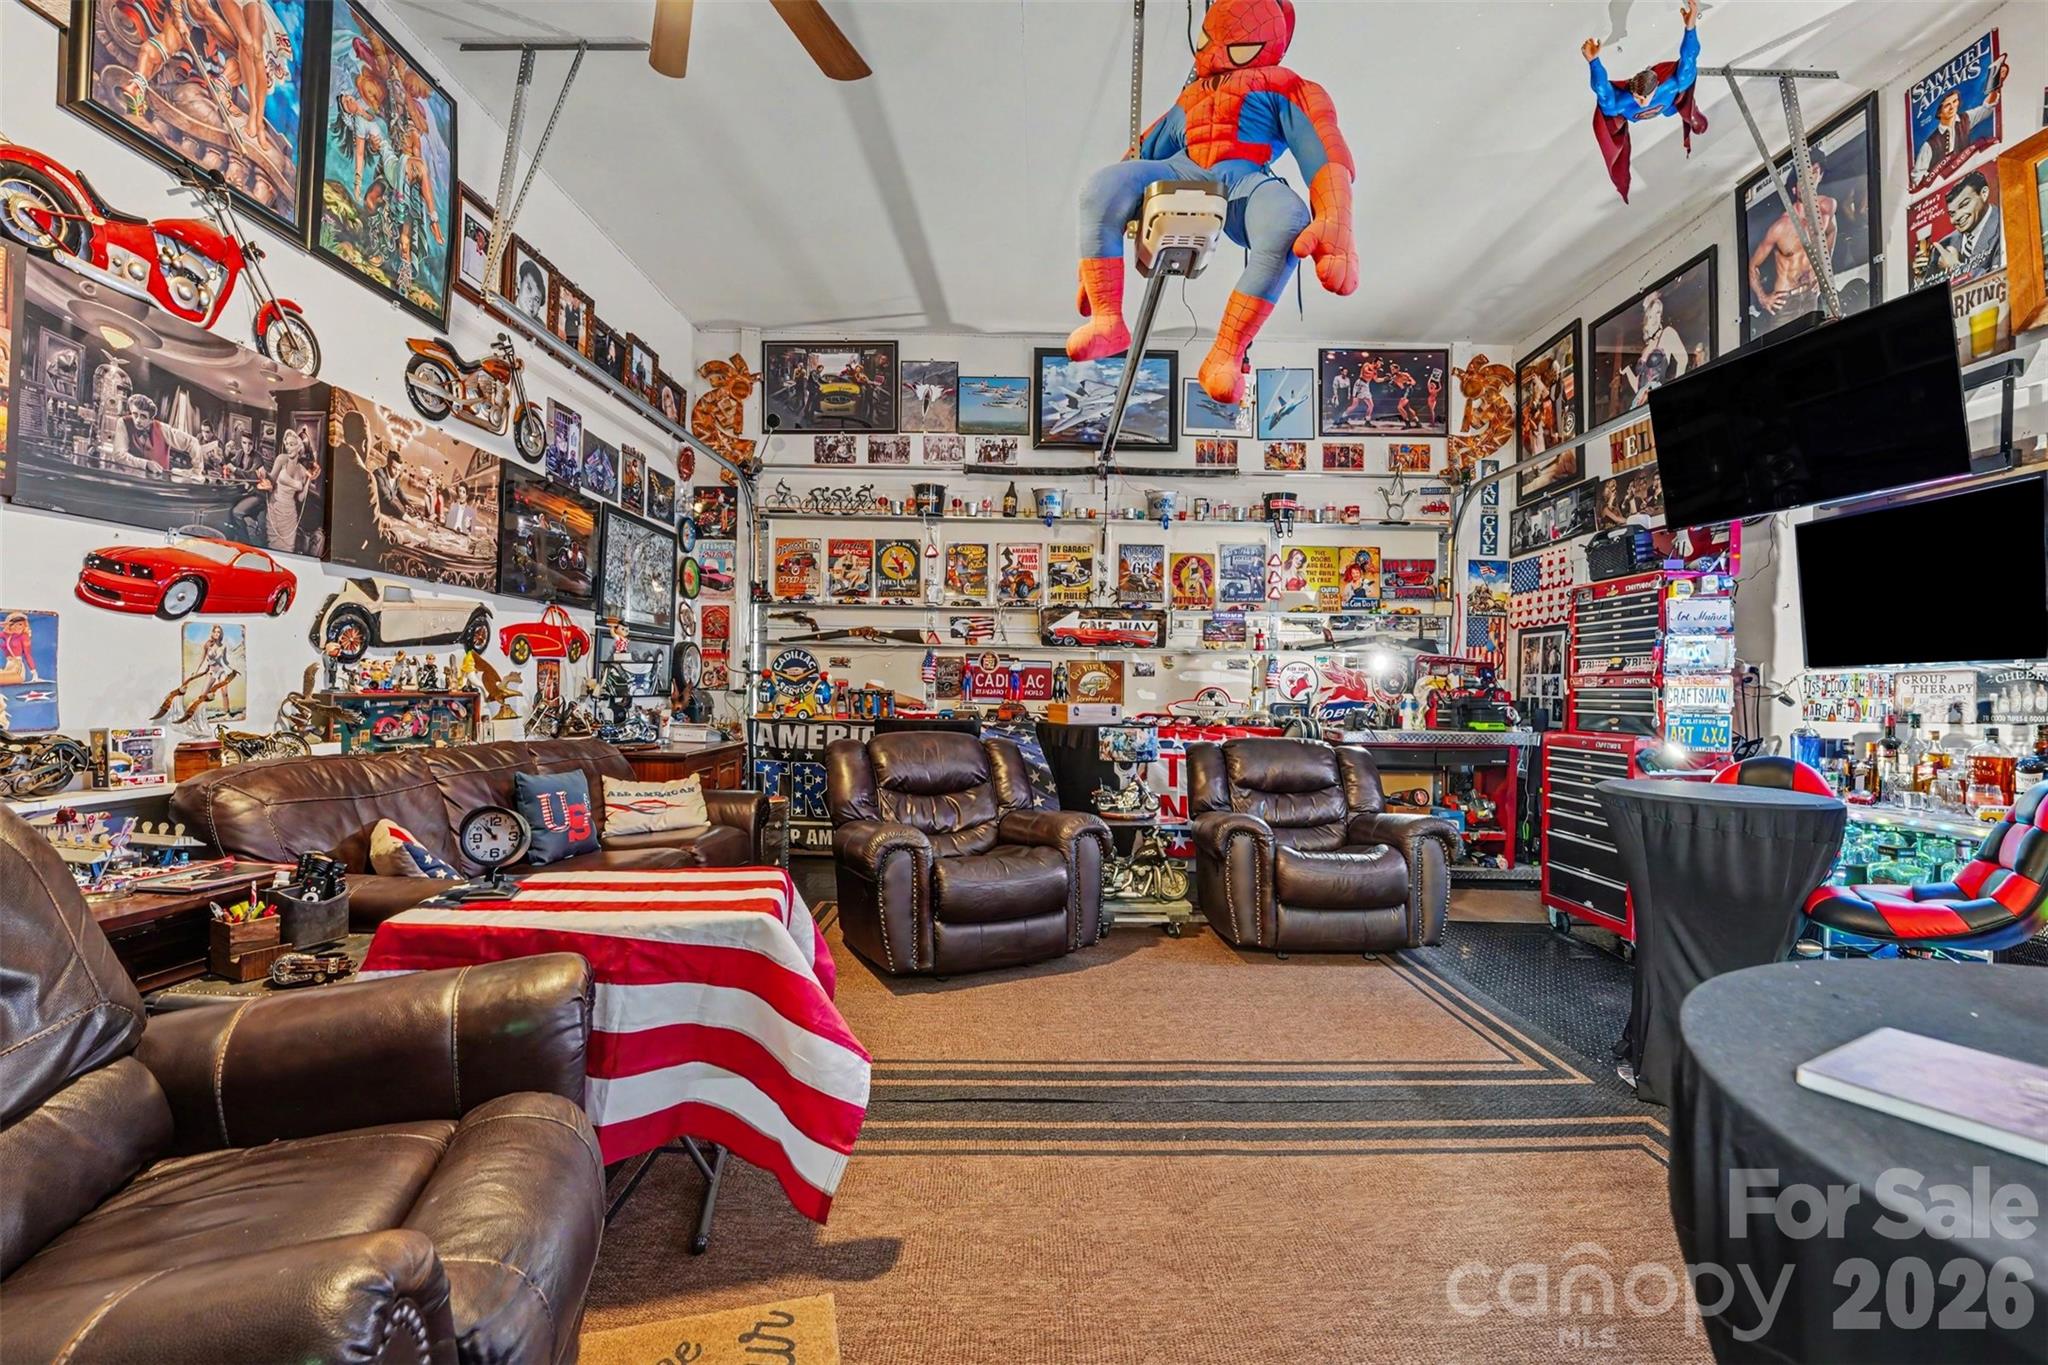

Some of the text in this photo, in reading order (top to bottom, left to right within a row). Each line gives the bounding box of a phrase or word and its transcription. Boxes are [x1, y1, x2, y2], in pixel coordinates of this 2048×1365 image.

[1912, 39, 1990, 104] SAMUEL
[1917, 59, 1982, 119] ADAMS
[1953, 282, 2007, 319] RKING
[1481, 515, 1496, 554] CAVE
[1050, 545, 1091, 553] MY GARAGE
[1132, 562, 1150, 574] 66
[1050, 592, 1088, 601] MY RULES
[1079, 620, 1154, 632] ONE WAY
[774, 651, 816, 671] CADILLAC
[974, 673, 1045, 688] CADIAC
[1902, 674, 1947, 684] GROUP
[1995, 670, 2048, 684] CHEER
[778, 680, 815, 696] SERVICE
[1911, 684, 1973, 694] THERAPY
[1668, 688, 1727, 704] CRAFTSMAN
[756, 723, 876, 750] AMERIC
[1671, 726, 1727, 744] ART 4X4
[607, 786, 696, 799] ALL AMERICAN
[754, 759, 831, 818] TR
[490, 816, 502, 827] 12
[473, 832, 483, 843] 9
[508, 831, 518, 841] 3
[490, 848, 500, 858] 6
